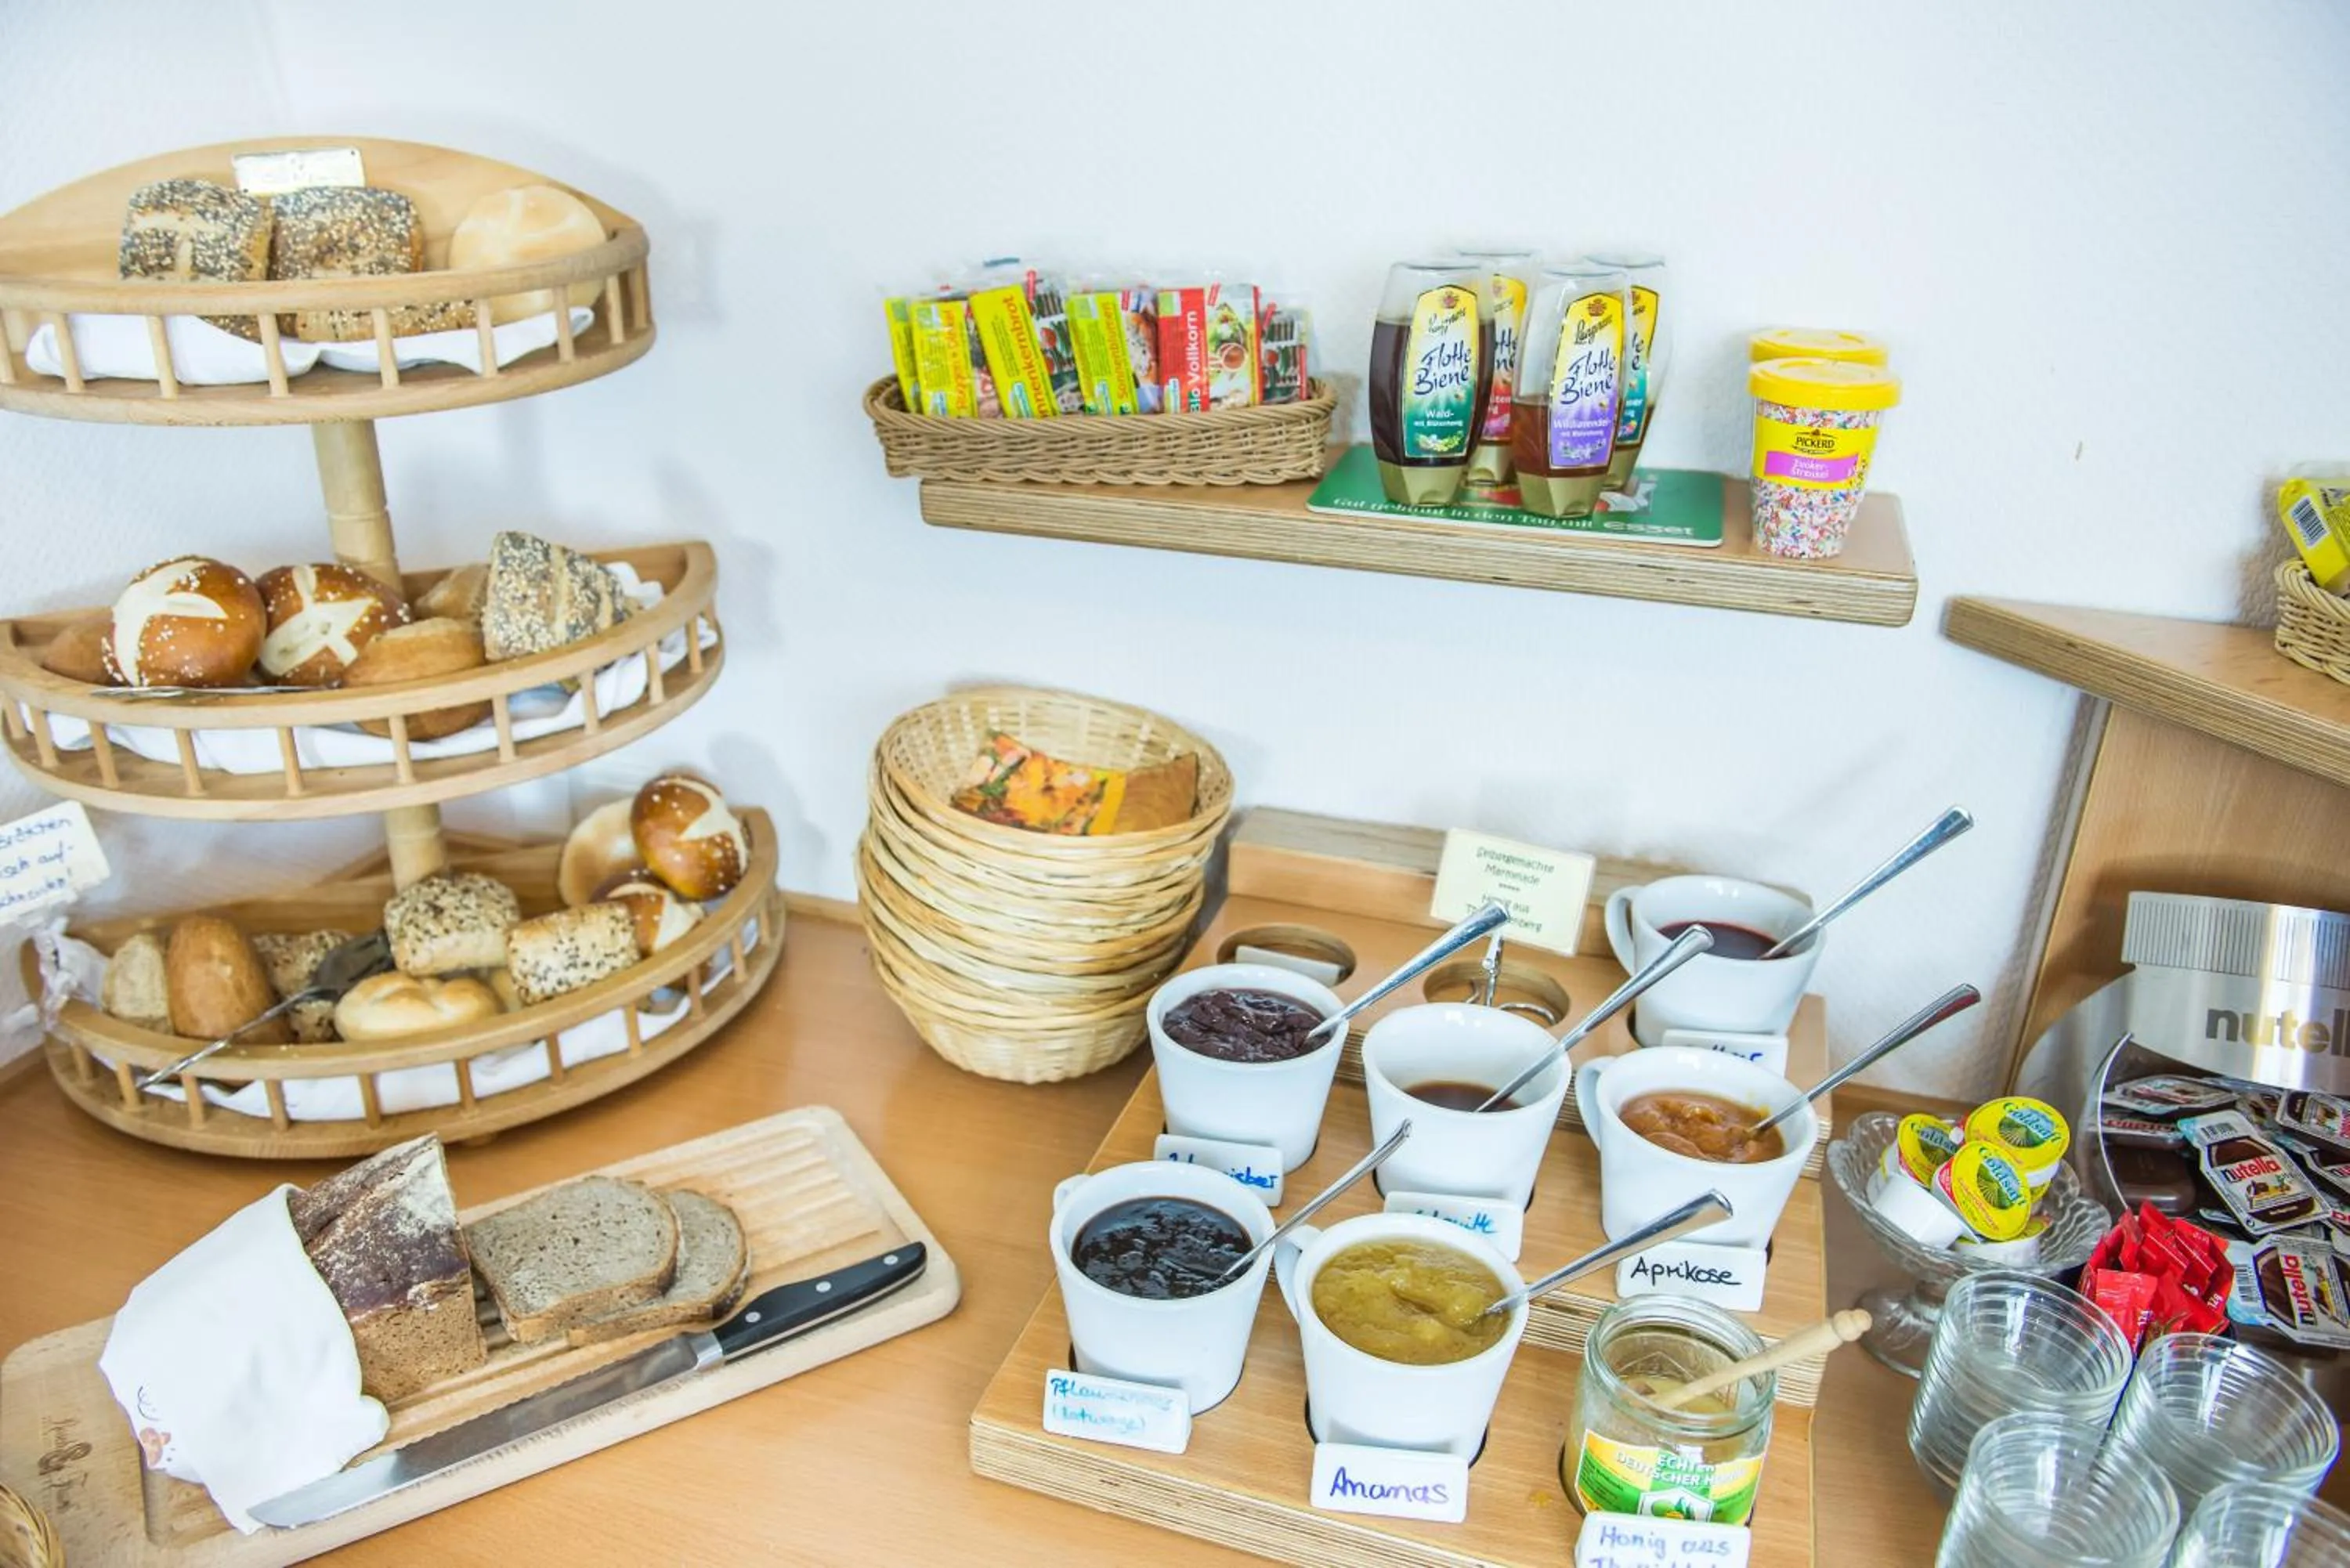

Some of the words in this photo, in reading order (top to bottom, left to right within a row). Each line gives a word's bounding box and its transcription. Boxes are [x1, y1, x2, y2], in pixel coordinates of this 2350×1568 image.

[1002, 295, 1048, 417] nnenkernbrot
[1185, 310, 1200, 385] Vollkorn
[1421, 340, 1472, 370] Flotte
[1568, 347, 1616, 378] Flotte
[1414, 365, 1469, 395] Biene
[1560, 374, 1613, 404] Biene
[1796, 437, 1835, 448] PICKERD
[2222, 1157, 2282, 1183] nutella
[1630, 1256, 1742, 1285] Aprikose
[2283, 1254, 2318, 1326] nutella
[1329, 1466, 1450, 1504] Ananas
[1600, 1525, 1666, 1559] Honig
[1681, 1539, 1731, 1556] aus
